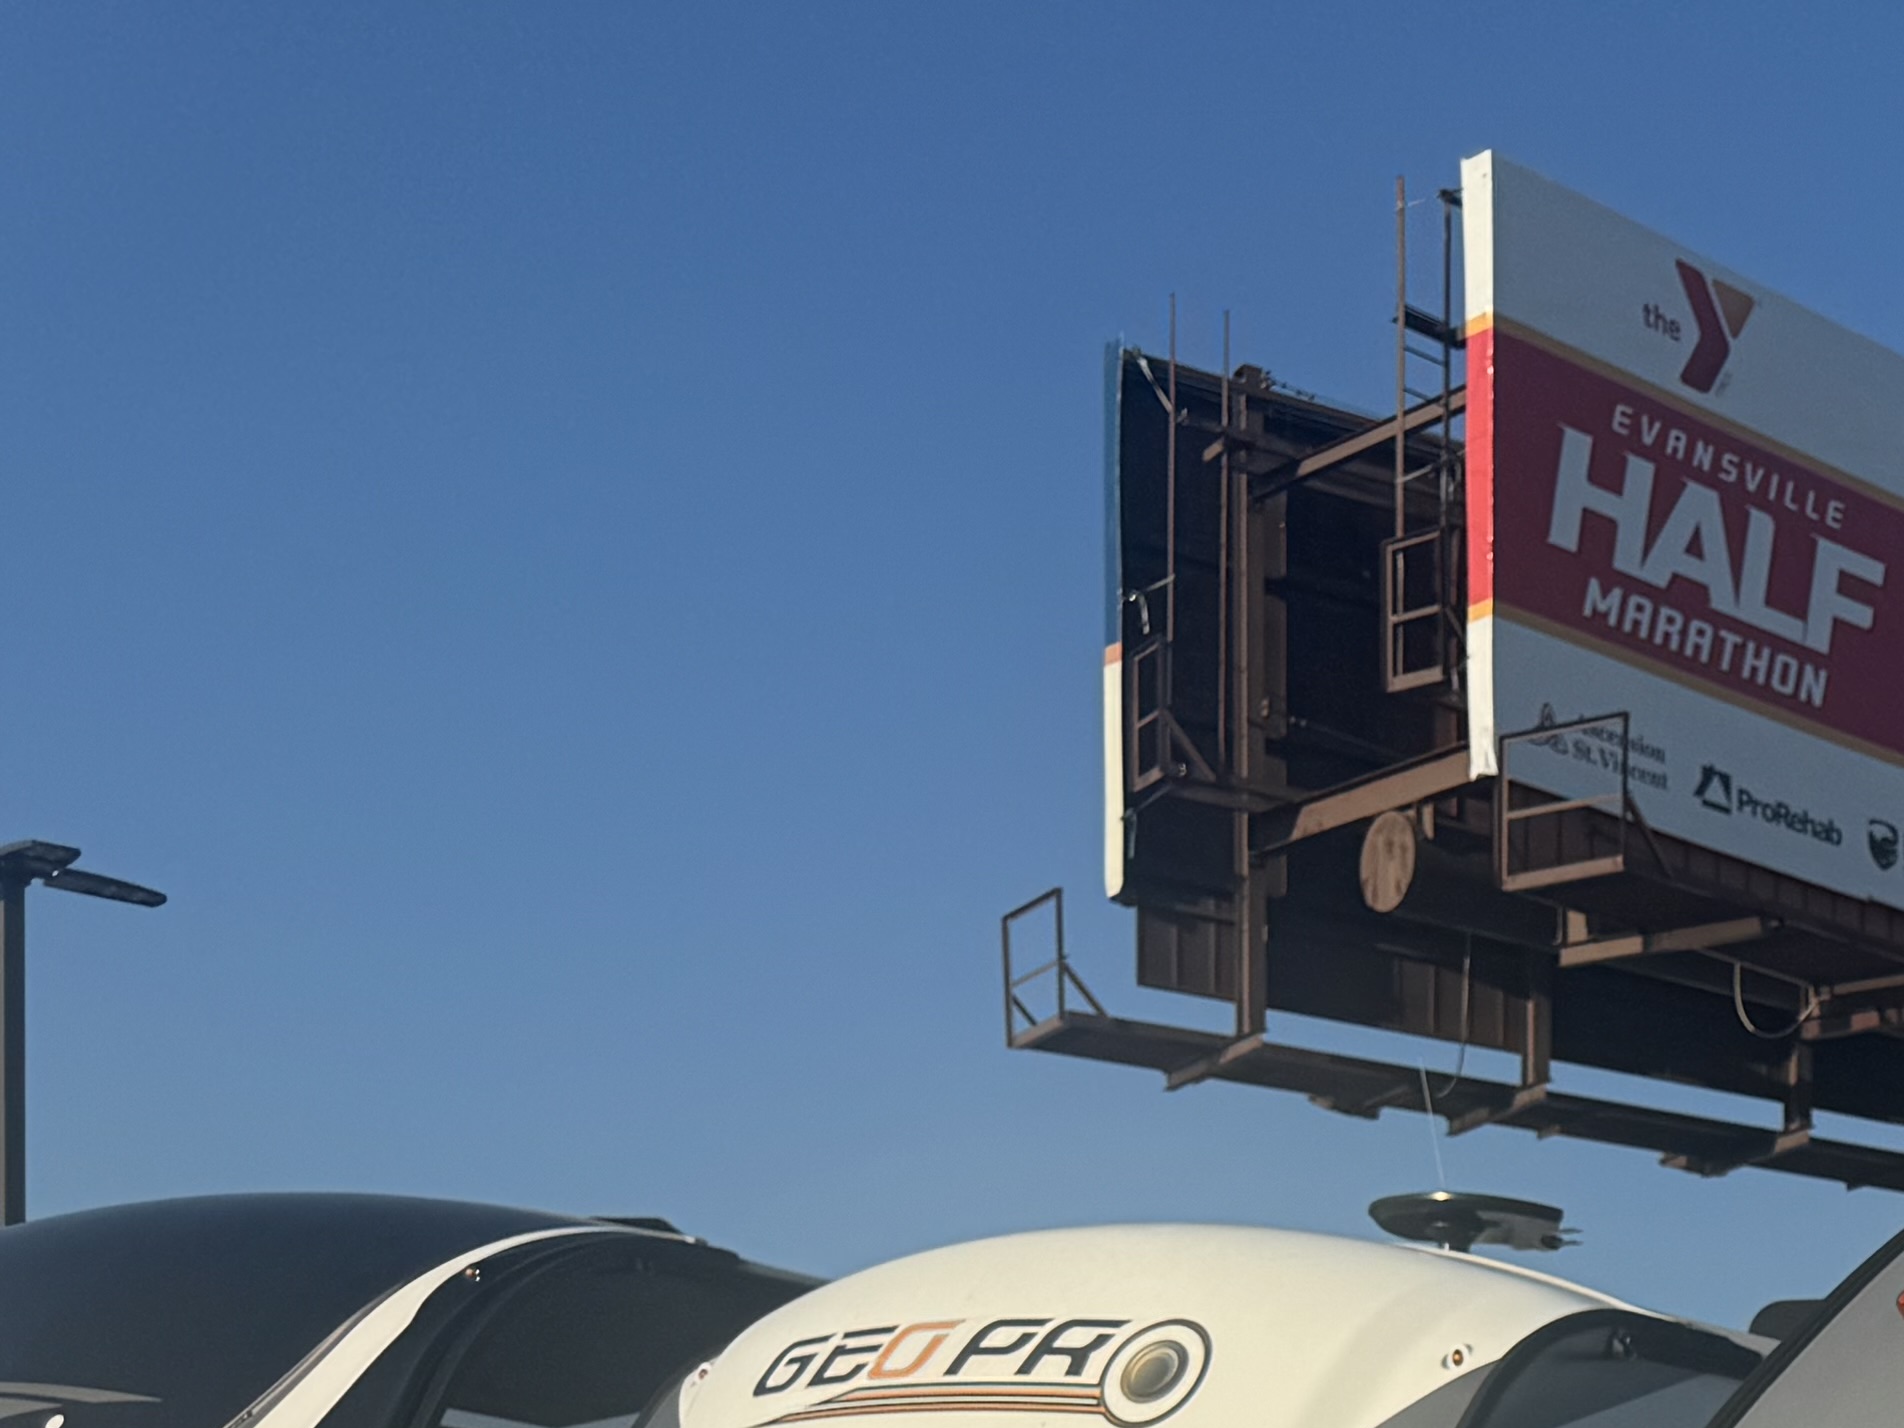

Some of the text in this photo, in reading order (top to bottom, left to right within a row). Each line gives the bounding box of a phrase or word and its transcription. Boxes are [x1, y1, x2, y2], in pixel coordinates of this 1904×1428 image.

[1642, 302, 1681, 342] the
[1612, 403, 1846, 530] EVANSVILLE
[1547, 422, 1886, 656] HALF
[1582, 577, 1829, 708] MARATHON
[1738, 786, 1843, 847] ProRehab
[752, 1317, 1212, 1428] GEO PRO
